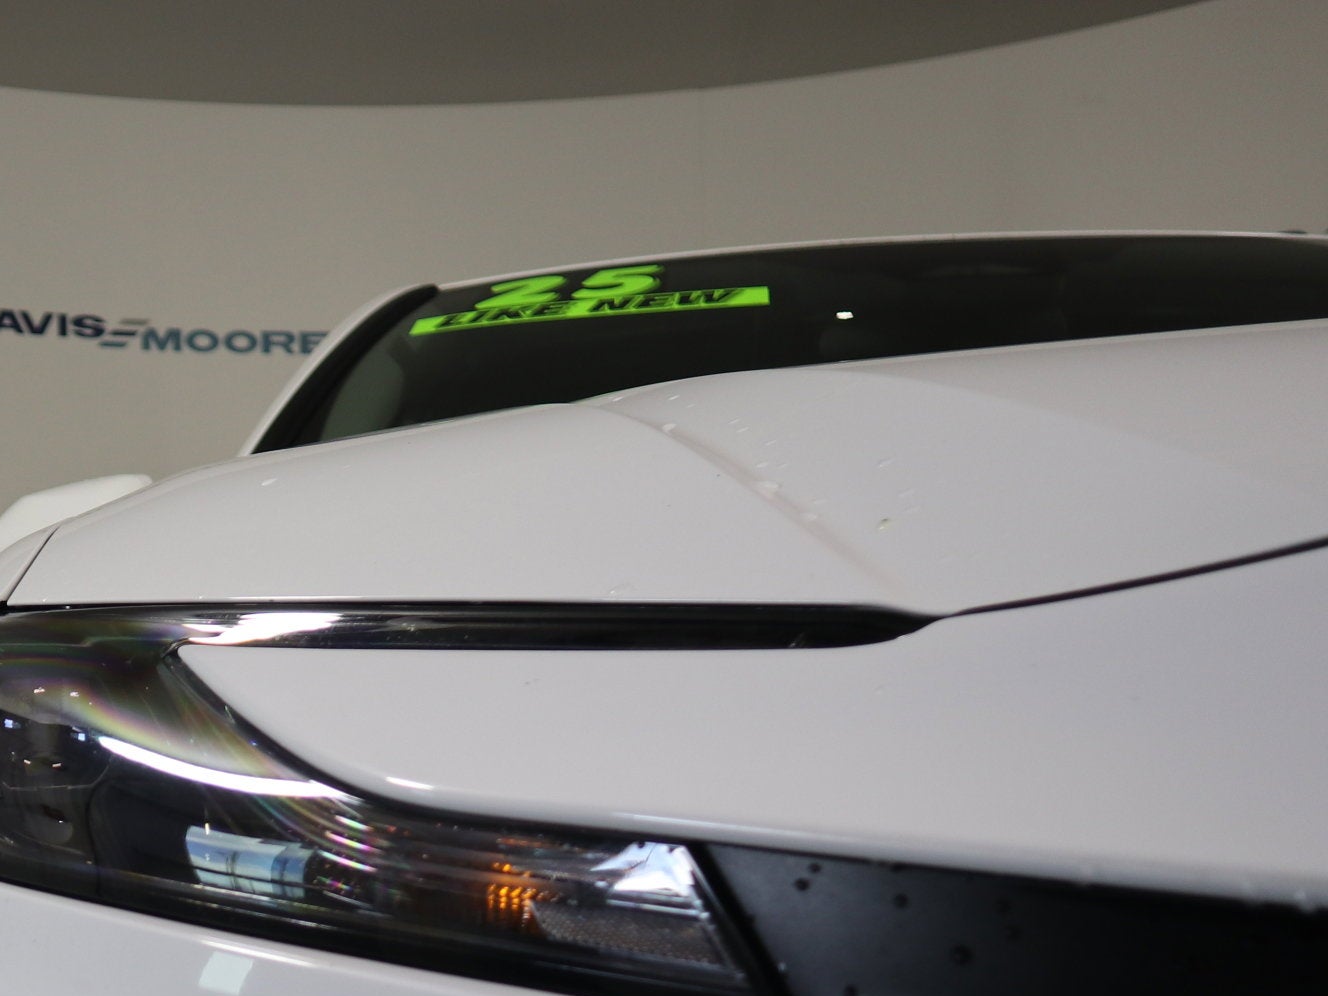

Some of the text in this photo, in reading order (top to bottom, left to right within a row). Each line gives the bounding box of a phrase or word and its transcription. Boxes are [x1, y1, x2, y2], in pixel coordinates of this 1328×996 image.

[474, 264, 663, 309] 25
[437, 288, 743, 328] LIKE NEW
[140, 327, 329, 354] MOORE
